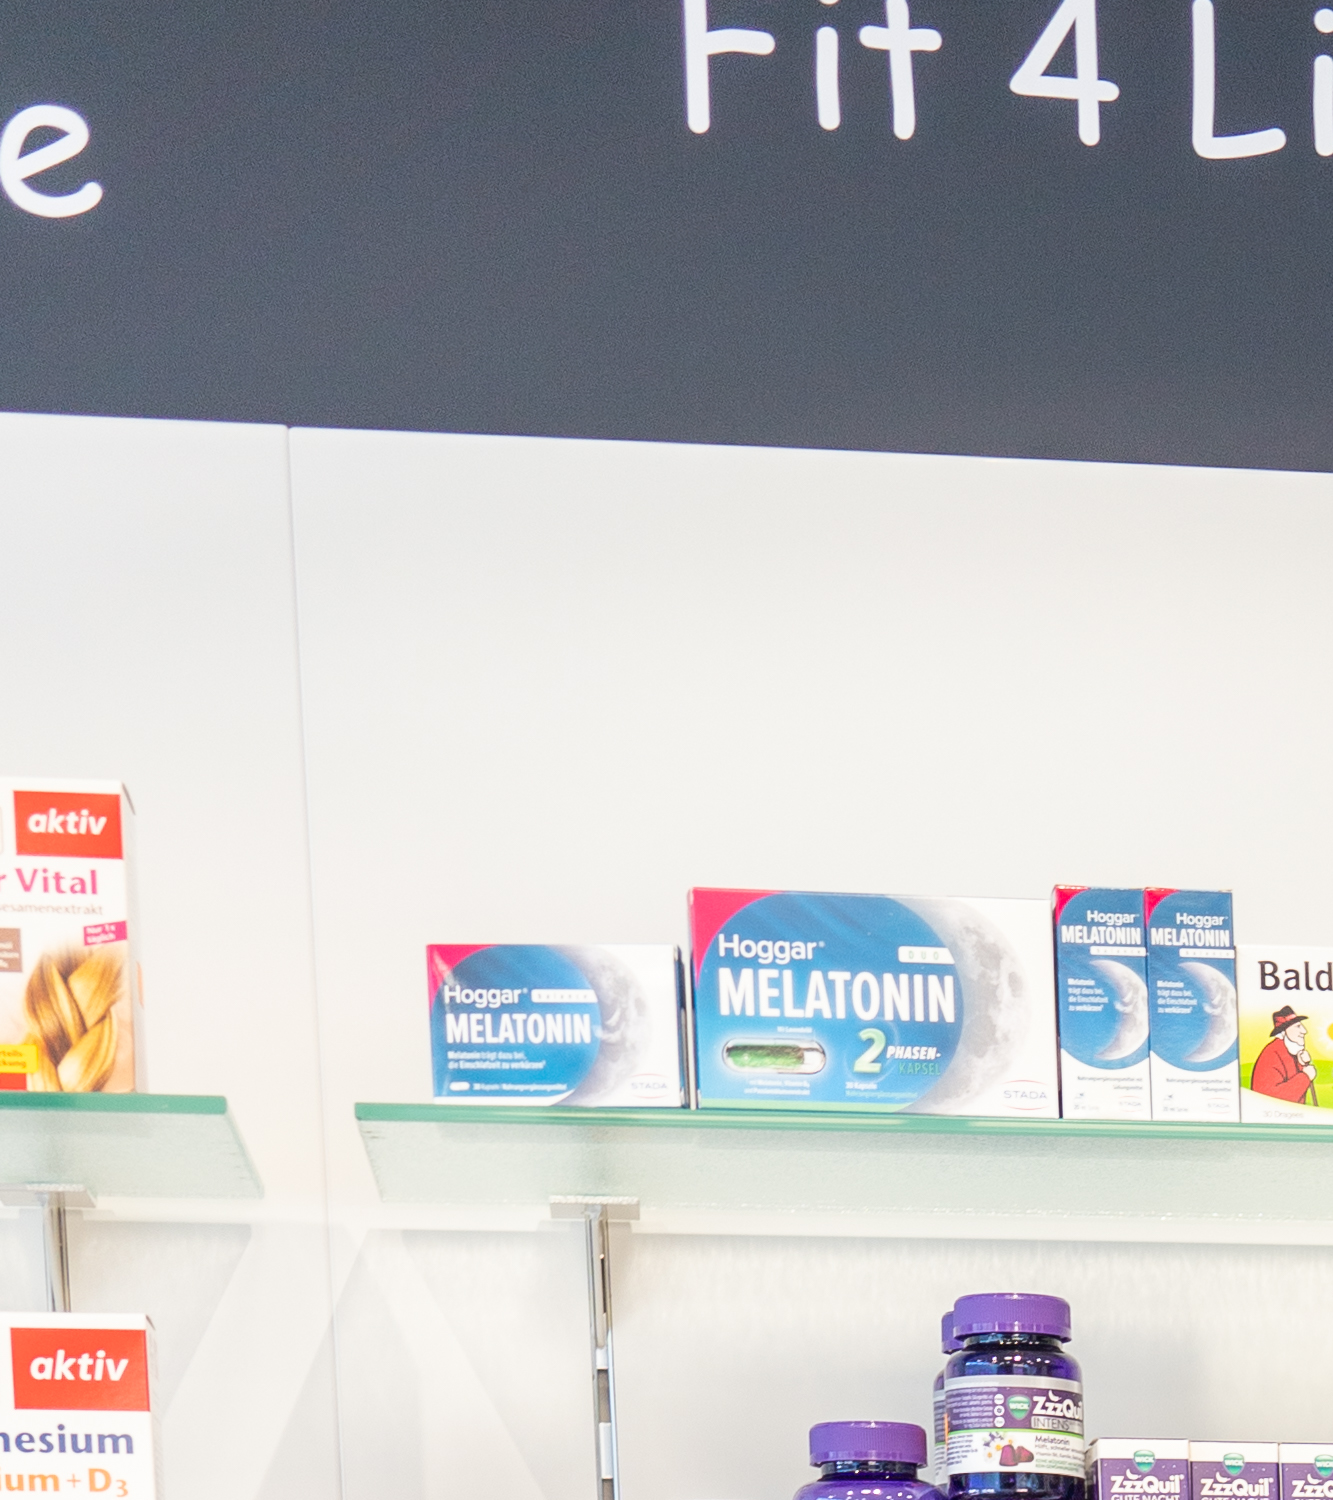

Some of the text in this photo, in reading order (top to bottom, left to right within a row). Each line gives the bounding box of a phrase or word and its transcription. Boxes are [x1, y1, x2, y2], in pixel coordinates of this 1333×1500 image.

[1009, 0, 1120, 145] 4
[27, 808, 107, 835] aktiv
[15, 868, 98, 895] Vital
[718, 934, 817, 964] Hoggar
[444, 985, 521, 1008] Hoggar
[720, 968, 956, 1023] MELATONIN
[445, 1013, 591, 1044] MELATONIN
[853, 1028, 885, 1074] 2
[887, 1045, 941, 1060] PHASEN-
[899, 1061, 941, 1076] KAPSEL
[30, 1350, 128, 1381] aktiv
